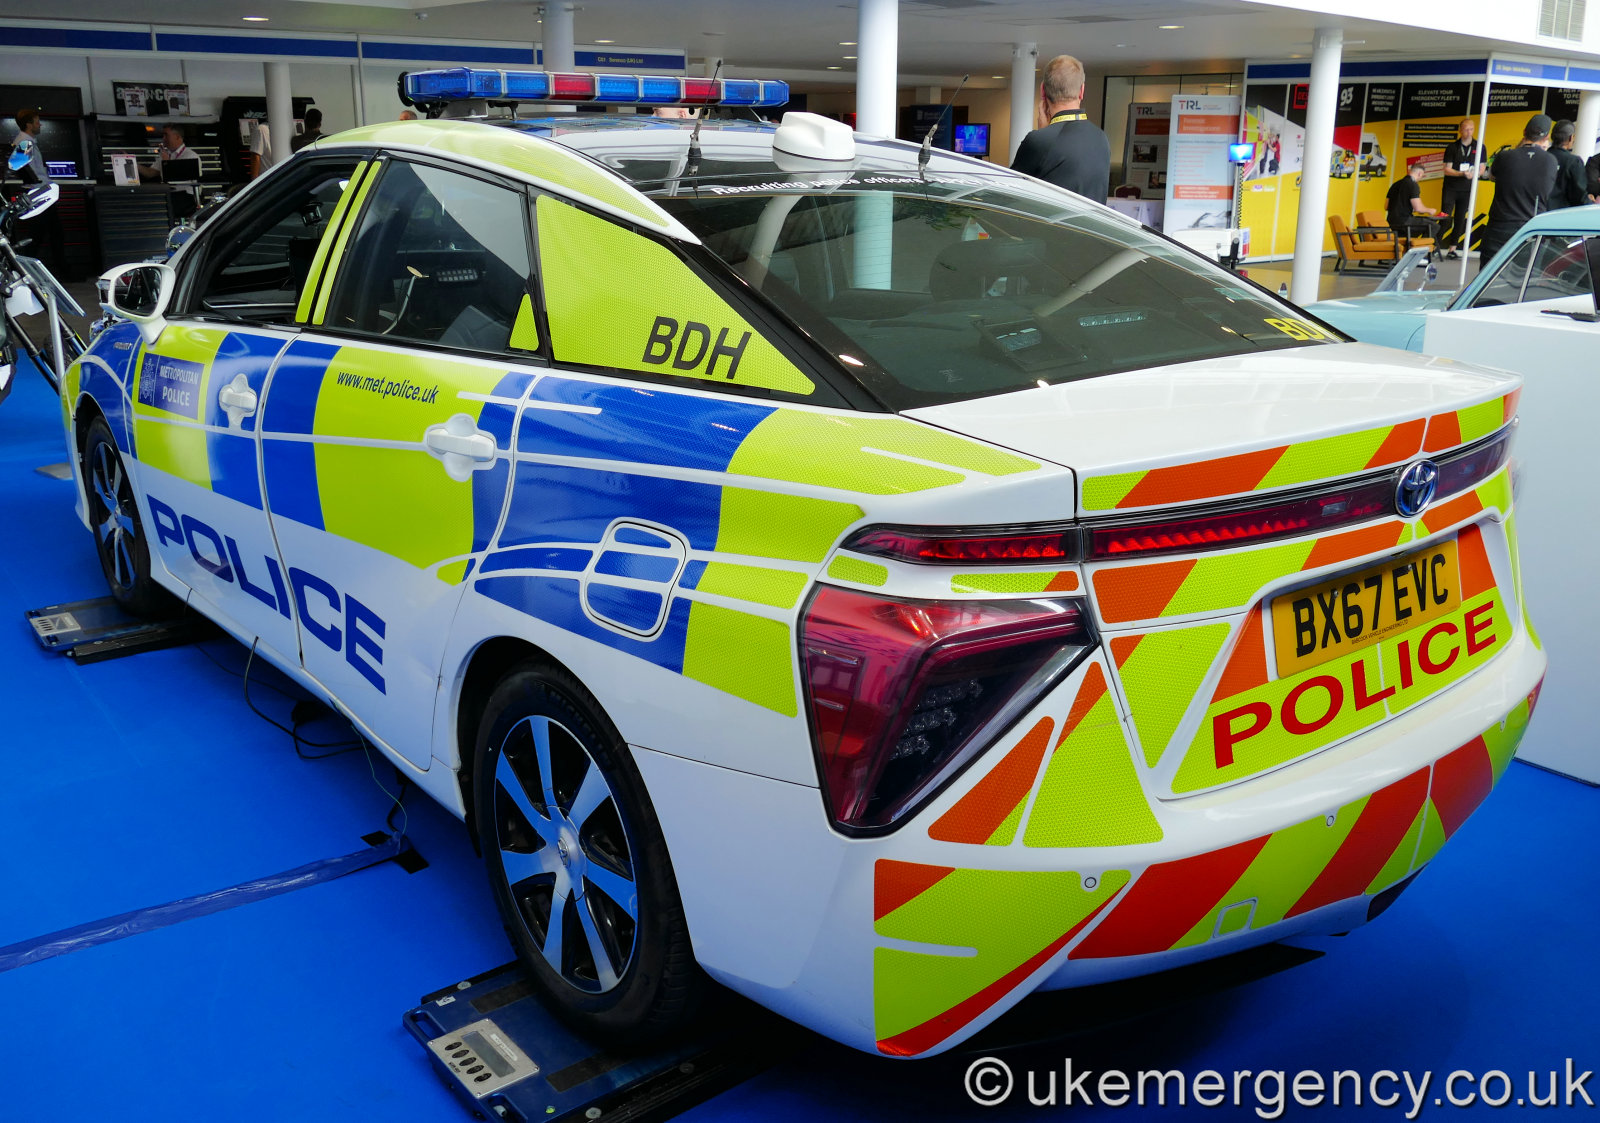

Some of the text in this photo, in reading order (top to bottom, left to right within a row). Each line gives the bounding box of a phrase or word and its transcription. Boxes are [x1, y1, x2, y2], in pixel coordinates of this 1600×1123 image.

[1136, 107, 1154, 115] TRL
[1179, 100, 1201, 111] TRL
[711, 180, 809, 195] Recruiting
[810, 177, 861, 188] police
[642, 315, 752, 380] BDH
[160, 365, 199, 385] METROPOLITAN
[337, 371, 439, 404] www.met.police.uk
[162, 386, 191, 407] POLICE
[146, 493, 387, 696] POLICE
[1292, 553, 1449, 658] BX67 EVC
[1212, 600, 1497, 769] POLICE
